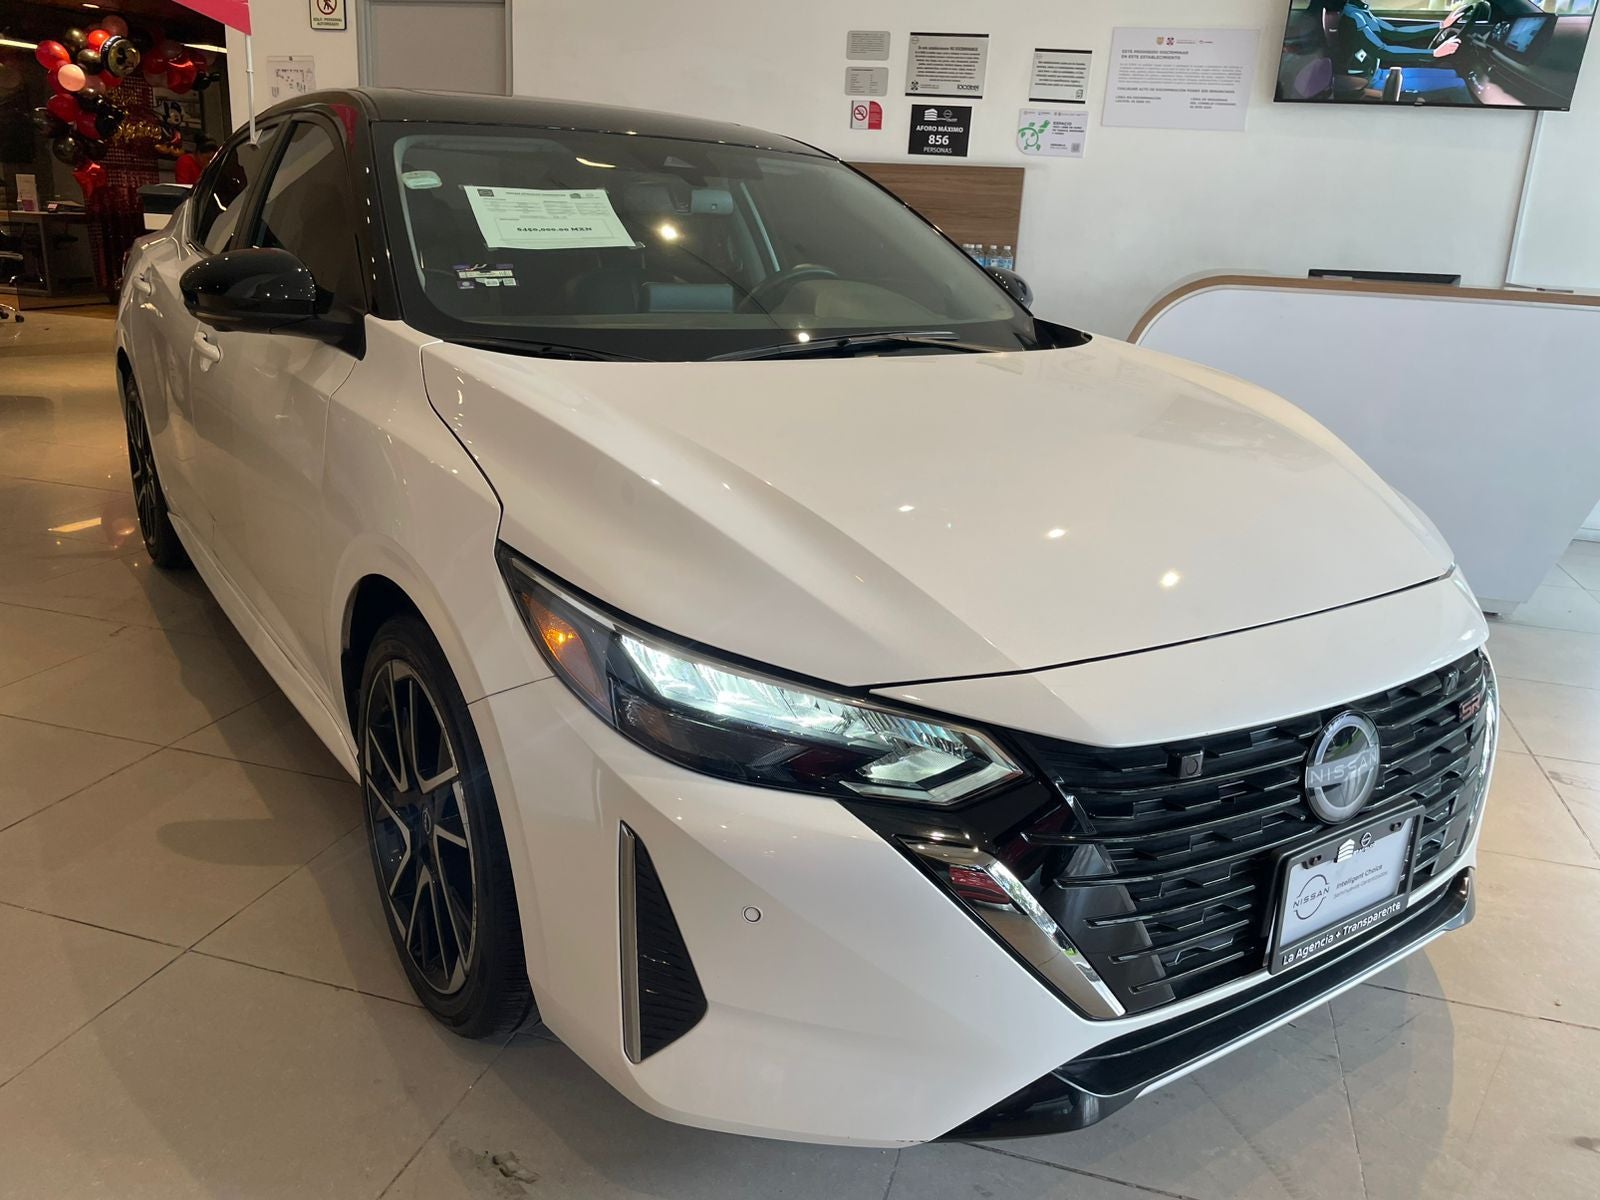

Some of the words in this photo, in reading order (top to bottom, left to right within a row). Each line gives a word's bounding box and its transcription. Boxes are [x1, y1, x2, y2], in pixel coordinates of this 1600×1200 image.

[928, 134, 949, 145] 856
[938, 125, 964, 133] MÁXIMO
[1462, 698, 1480, 720] SR
[1310, 750, 1377, 784] NISSAN
[1336, 872, 1365, 889] Intelligent
[1365, 864, 1383, 877] Choice
[1293, 886, 1330, 908] NISSAN
[1283, 953, 1294, 966] La
[1295, 933, 1334, 959] Agencia
[1342, 901, 1401, 936] Transparente
